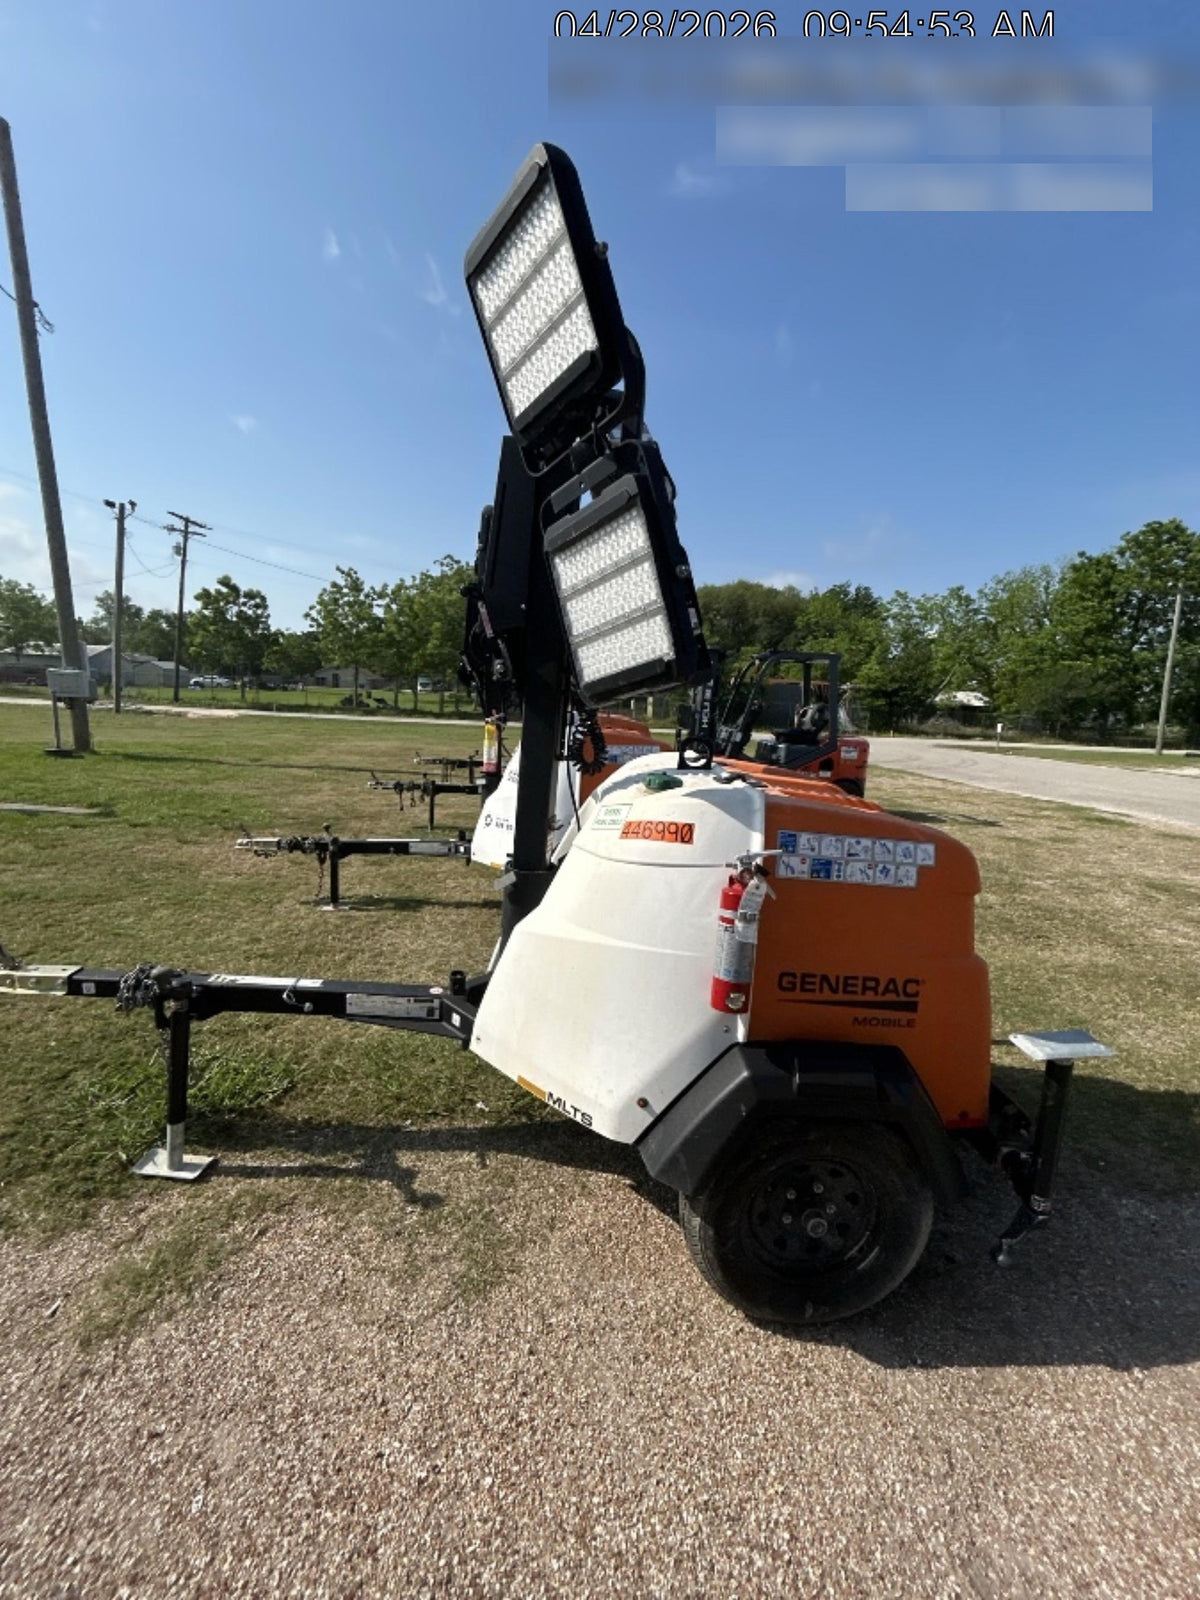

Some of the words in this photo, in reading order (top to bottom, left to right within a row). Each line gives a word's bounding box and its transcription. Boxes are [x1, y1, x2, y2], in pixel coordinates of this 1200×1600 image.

[622, 820, 694, 843] 446990
[777, 971, 921, 998] GENERAC
[852, 1016, 916, 1028] MOBILE
[547, 1091, 592, 1127] MLTS
